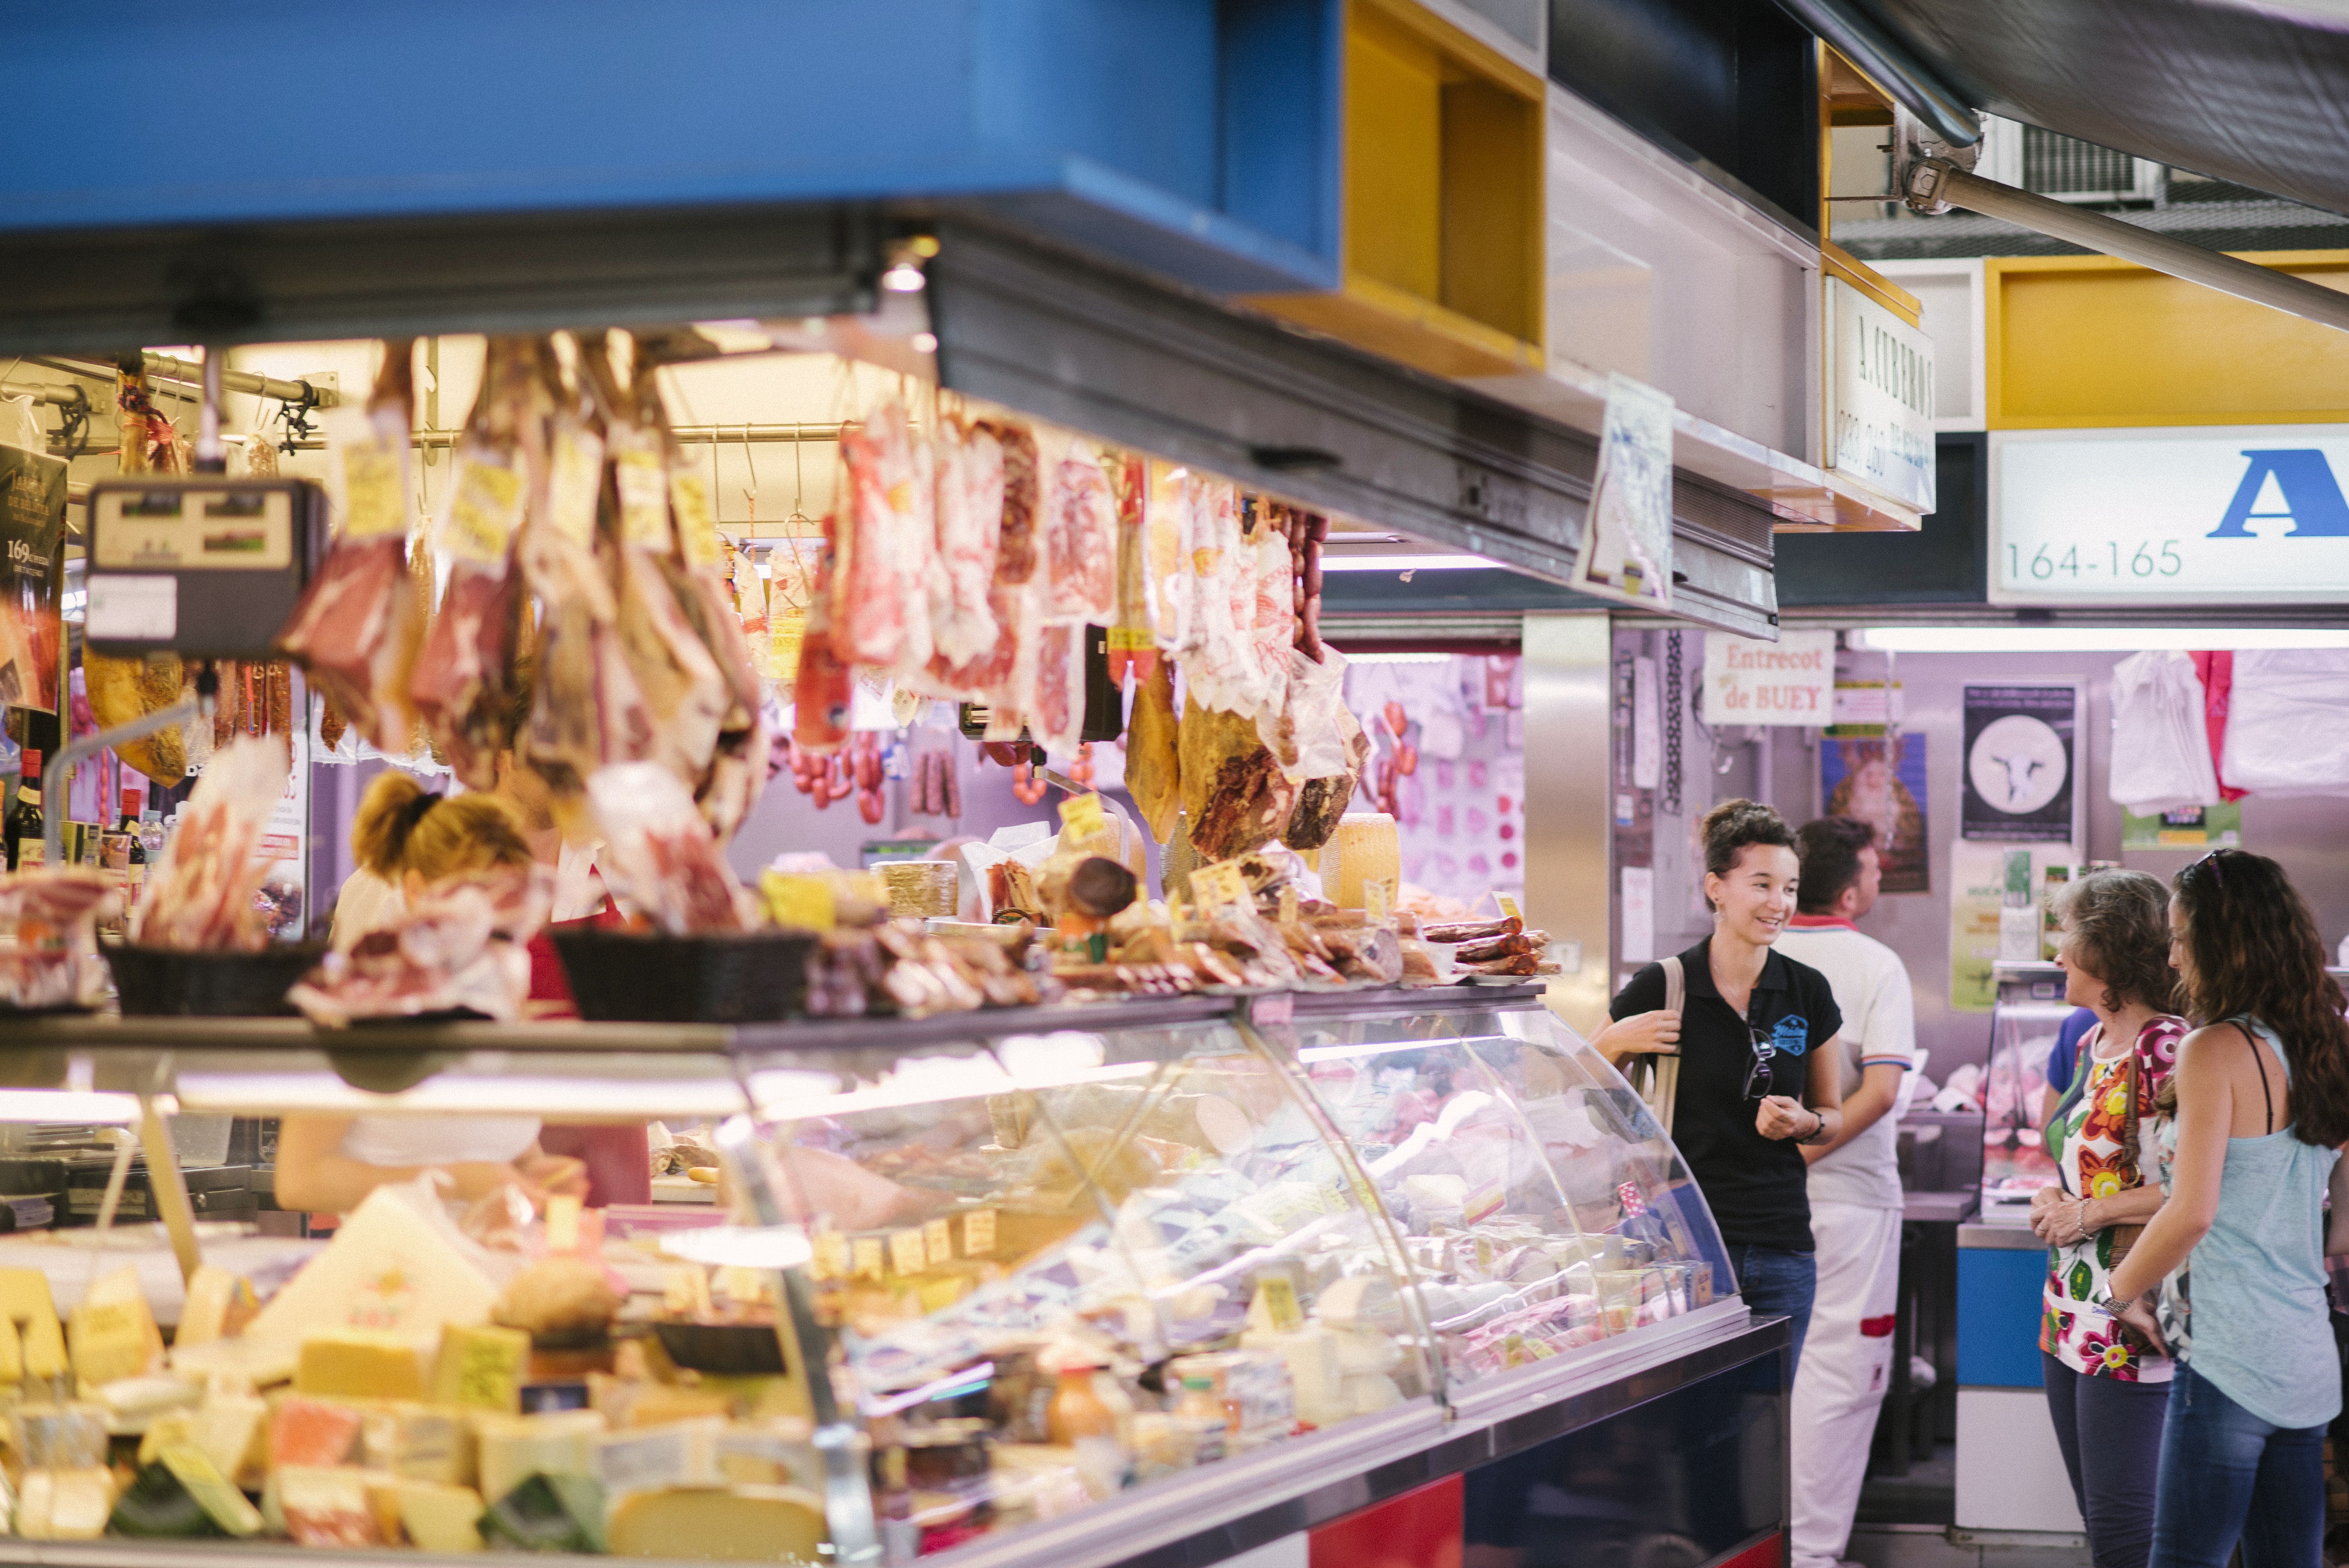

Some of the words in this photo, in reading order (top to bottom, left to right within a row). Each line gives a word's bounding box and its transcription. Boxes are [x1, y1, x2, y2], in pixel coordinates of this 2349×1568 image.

[7, 540, 30, 563] 169
[2007, 540, 2182, 579] 164-165
[1727, 644, 1822, 670] Entrecot
[1725, 686, 1749, 709] de
[1757, 685, 1821, 710] BUEY
